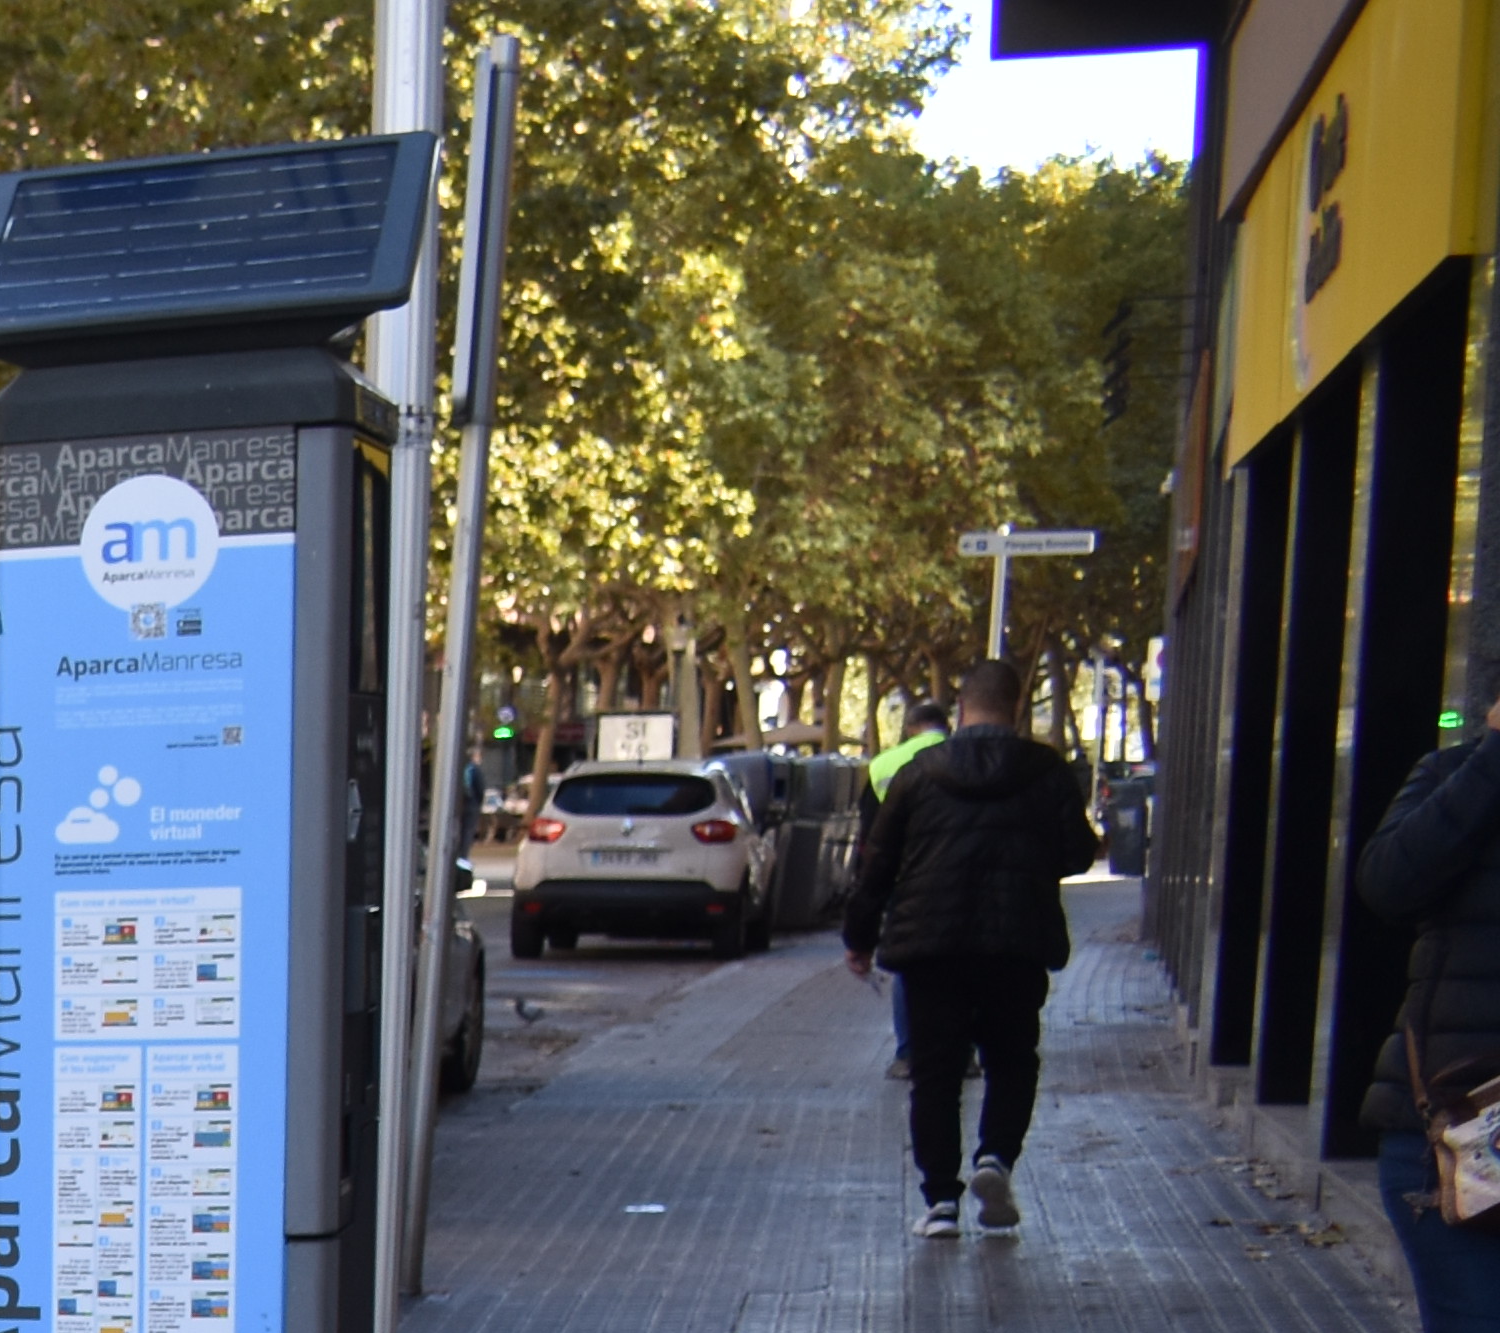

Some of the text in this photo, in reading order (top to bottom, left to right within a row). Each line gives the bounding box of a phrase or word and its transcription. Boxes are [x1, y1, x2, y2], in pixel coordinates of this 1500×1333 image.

[101, 517, 197, 565] am
[102, 567, 196, 584] AparcaManresa
[56, 651, 243, 682] AparcaManresa
[151, 804, 242, 823] El moneder
[150, 823, 203, 841] virtual
